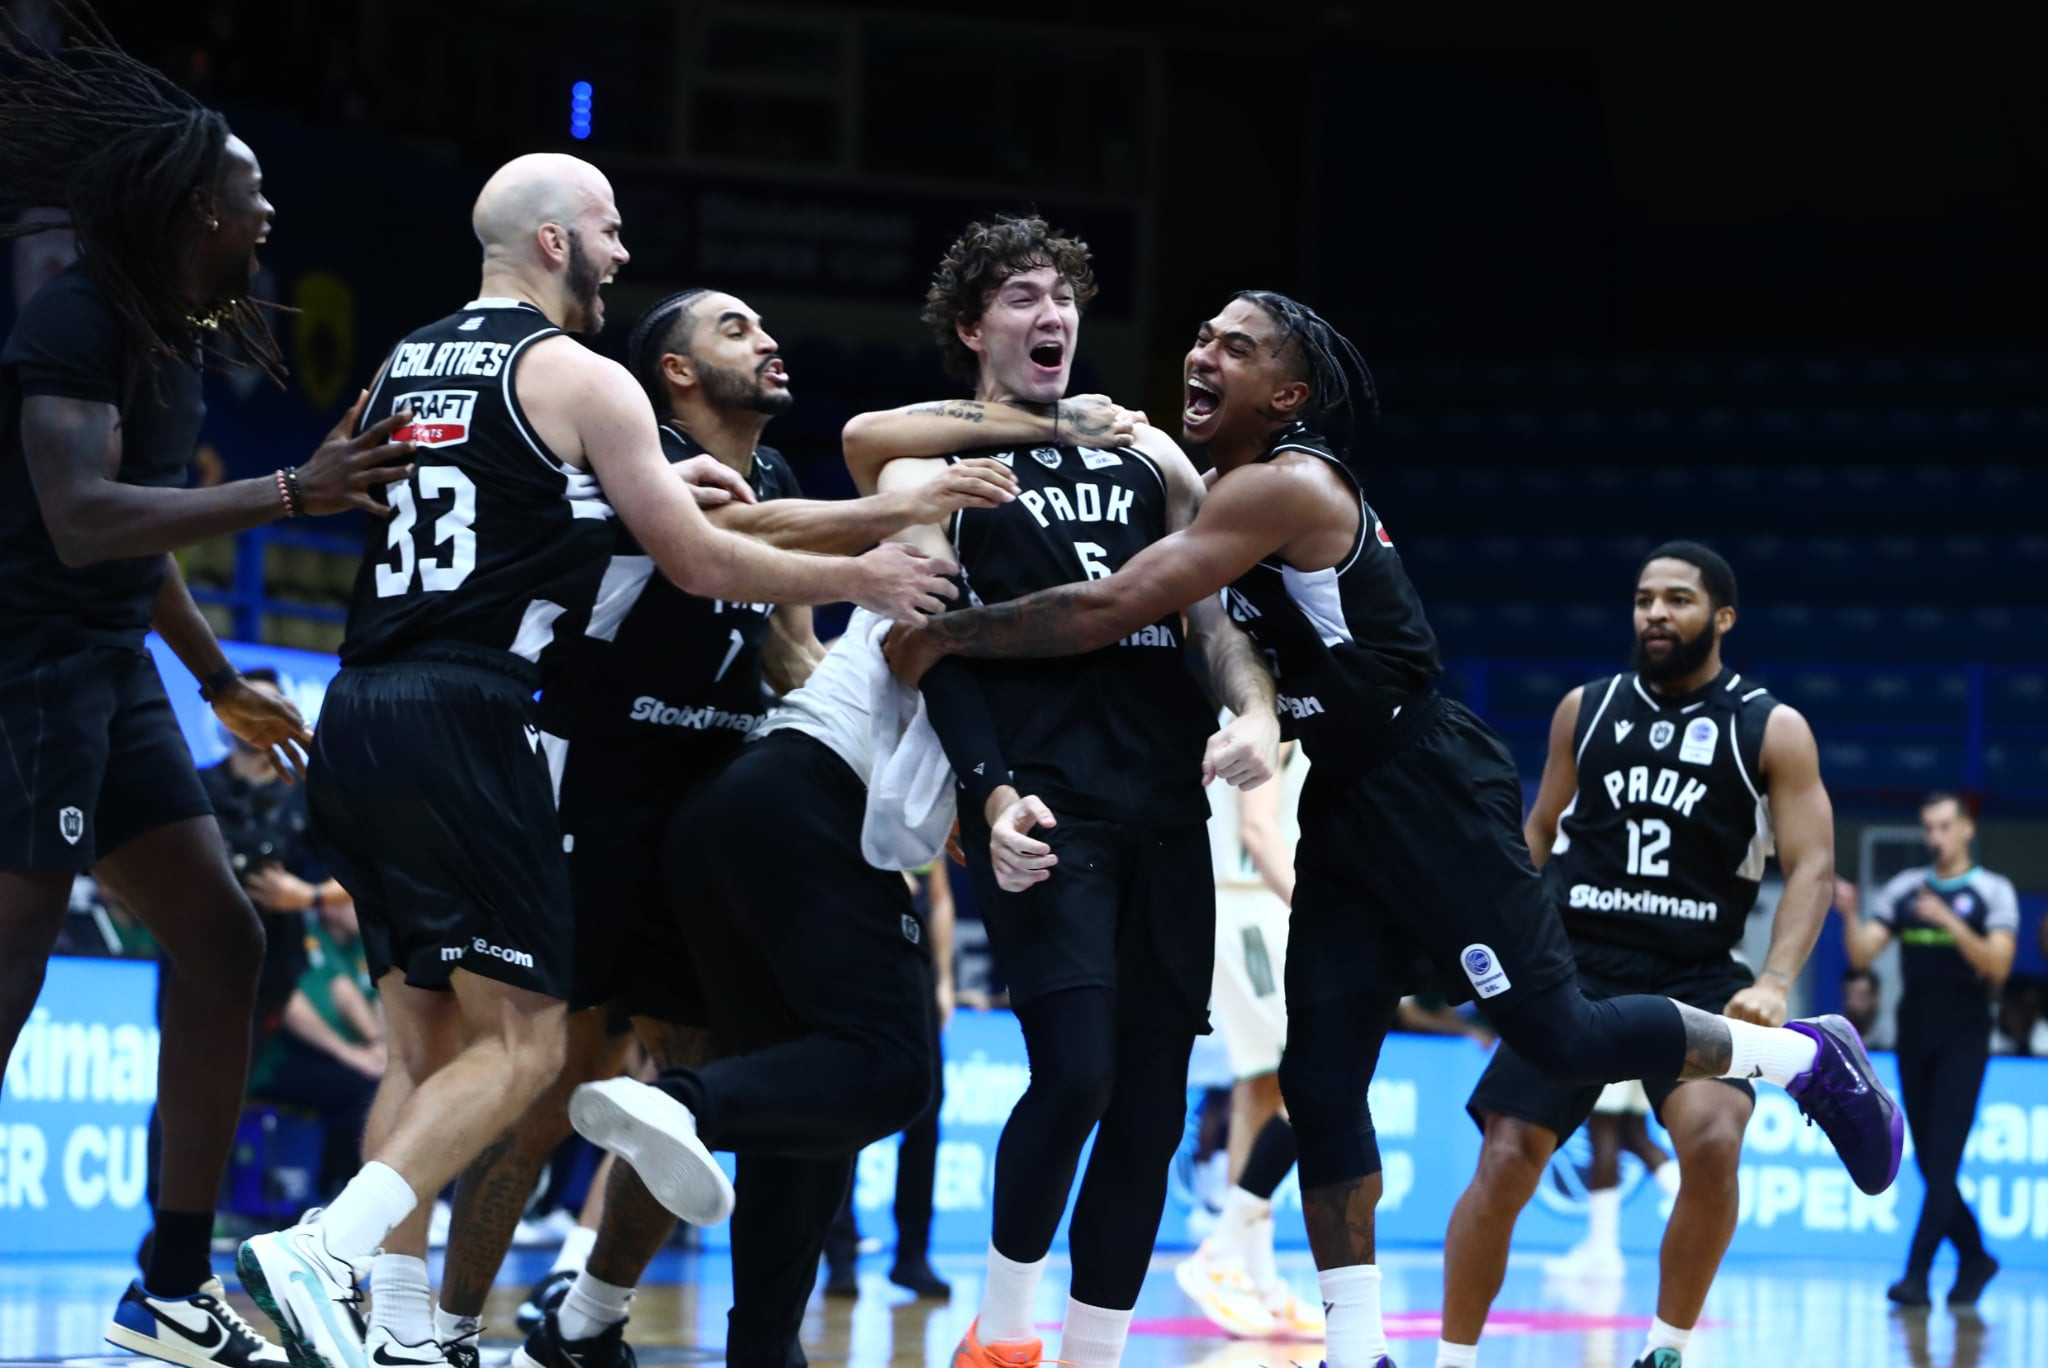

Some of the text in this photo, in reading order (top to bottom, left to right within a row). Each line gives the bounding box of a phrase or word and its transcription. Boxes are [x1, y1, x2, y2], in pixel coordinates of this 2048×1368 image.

[390, 341, 511, 378] GALATHES
[1017, 482, 1135, 529] PAOK
[375, 465, 477, 598] 33
[1603, 765, 1708, 817] PAOK
[1626, 818, 1671, 877] 12
[1569, 883, 1718, 921] Stoiximan
[440, 937, 535, 968] me.com
[63, 1123, 148, 1210] CU
